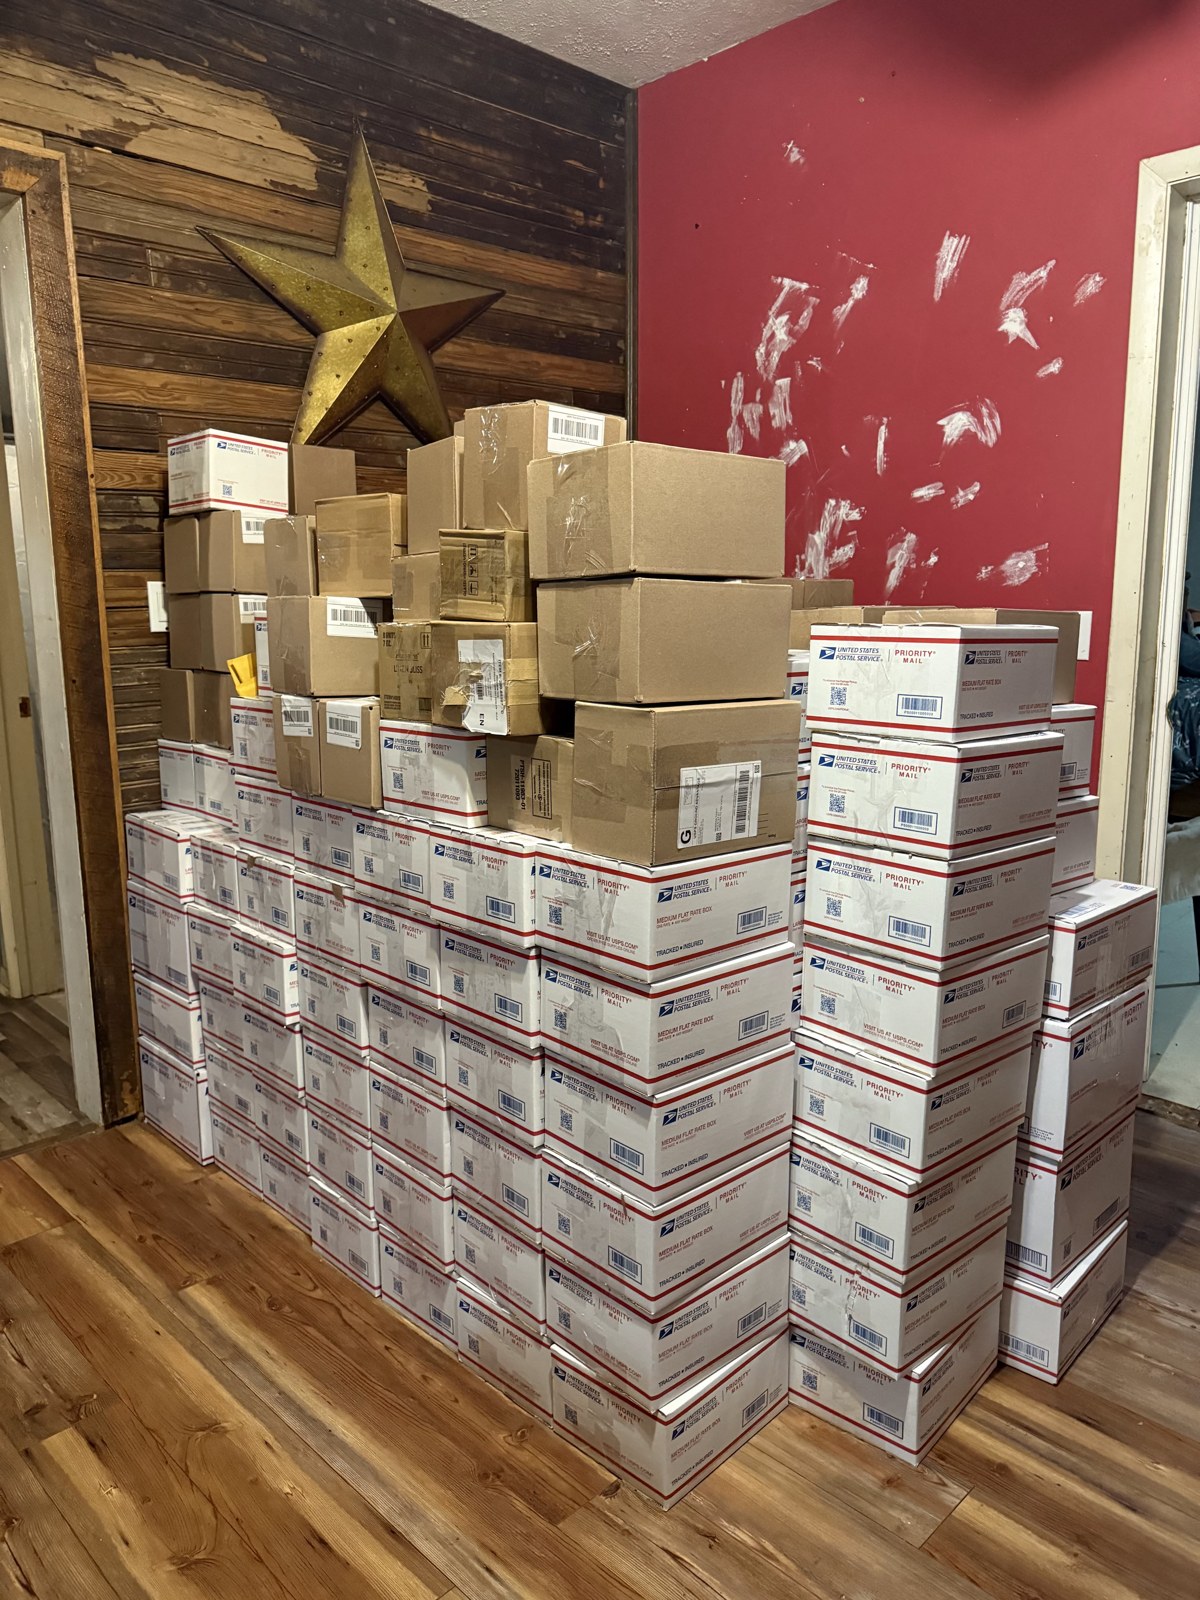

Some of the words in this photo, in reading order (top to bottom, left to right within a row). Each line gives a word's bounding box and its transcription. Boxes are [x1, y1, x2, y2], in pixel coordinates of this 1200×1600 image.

[480, 713, 484, 726] EN
[680, 830, 692, 844] G
[553, 867, 570, 876] UNITED
[831, 868, 851, 877] POSTAL
[832, 861, 853, 869] UNITED
[853, 865, 872, 873] STATES
[552, 874, 569, 883] POSTAL
[674, 882, 692, 891] UNITED
[693, 879, 708, 887] STATES
[893, 882, 912, 890] MAIL
[604, 888, 619, 896] MAIL
[673, 891, 691, 900] POSTAL
[656, 914, 677, 924] MEDIUM
[655, 946, 679, 957] TRACKED
[683, 939, 704, 950] INSURED
[825, 966, 845, 976] POSTAL
[826, 960, 846, 970] UNITED
[846, 966, 865, 975] STATES
[557, 979, 574, 990] POSTAL
[559, 972, 575, 982] UNITED
[575, 978, 590, 988] STATES
[675, 994, 693, 1004] UNITED
[694, 989, 710, 999] STATES
[727, 987, 740, 996] MAIL
[886, 986, 903, 995] MAIL
[608, 998, 622, 1008] MAIL
[674, 1003, 692, 1013] POSTAL
[657, 1026, 678, 1038] MEDIUM
[679, 1023, 690, 1031] FLAT
[691, 1019, 702, 1028] RATE
[704, 1015, 714, 1023] BOX
[864, 1022, 876, 1032] VISIT
[657, 1057, 681, 1070] TRACKED
[684, 1048, 705, 1061] INSURED
[814, 1067, 834, 1078] POSTAL
[815, 1061, 835, 1072] UNITED
[835, 1068, 853, 1078] STATES
[563, 1080, 579, 1092] POSTAL
[564, 1074, 580, 1085] UNITED
[580, 1081, 595, 1092] STATES
[730, 1089, 743, 1099] MAIL
[874, 1091, 892, 1101] MAIL
[679, 1100, 696, 1112] UNITED
[697, 1094, 712, 1105] STATES
[612, 1104, 627, 1115] MAIL
[678, 1109, 695, 1120] POSTAL
[661, 1133, 682, 1147] MEDIUM
[683, 1129, 693, 1138] FLAT
[695, 1124, 706, 1133] RATE
[707, 1119, 717, 1128] BOX
[661, 1163, 684, 1178] TRACKED
[688, 1153, 709, 1167] INSURED
[801, 1164, 820, 1176] POSTAL
[803, 1158, 821, 1170] UNITED
[560, 1185, 576, 1198] POSTAL
[561, 1179, 577, 1191] UNITED
[577, 1187, 592, 1199] STATES
[859, 1191, 876, 1203] MAIL
[610, 1213, 624, 1226] MAIL
[796, 1251, 815, 1265] UNITED
[815, 1261, 832, 1274] STATES
[796, 1258, 814, 1272] POSTAL
[561, 1280, 576, 1294] POSTAL
[562, 1274, 577, 1288] UNITED
[578, 1284, 592, 1297] STATES
[609, 1312, 623, 1324] MAIL
[806, 1345, 826, 1358] POSTAL
[807, 1339, 827, 1351] UNITED
[827, 1348, 845, 1360] STATES
[567, 1373, 584, 1387] UNITED
[584, 1383, 600, 1396] STATES
[866, 1374, 884, 1385] MAIL
[567, 1379, 583, 1393] POSTAL
[618, 1412, 633, 1425] MAIL
